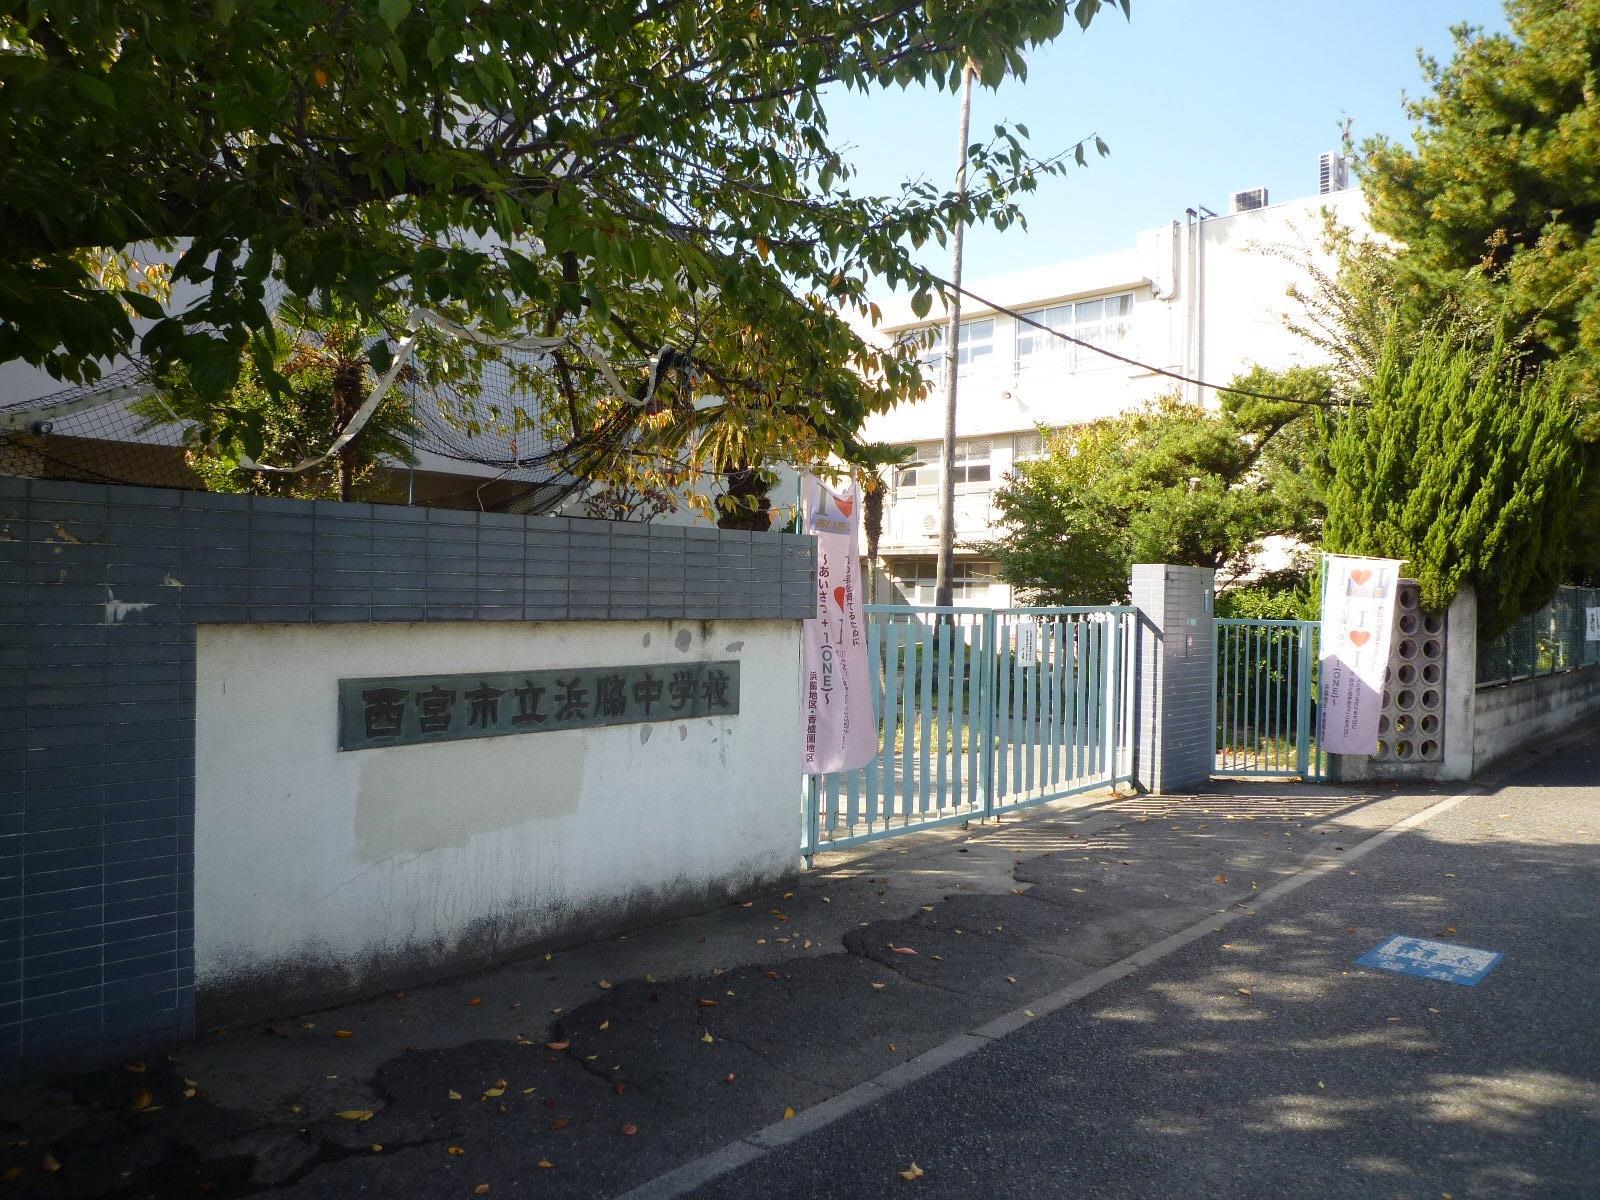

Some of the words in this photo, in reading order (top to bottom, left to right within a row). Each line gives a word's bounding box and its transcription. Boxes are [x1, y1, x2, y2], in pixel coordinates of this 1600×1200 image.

[361, 669, 731, 739] 西宮市立浜脇中学校
